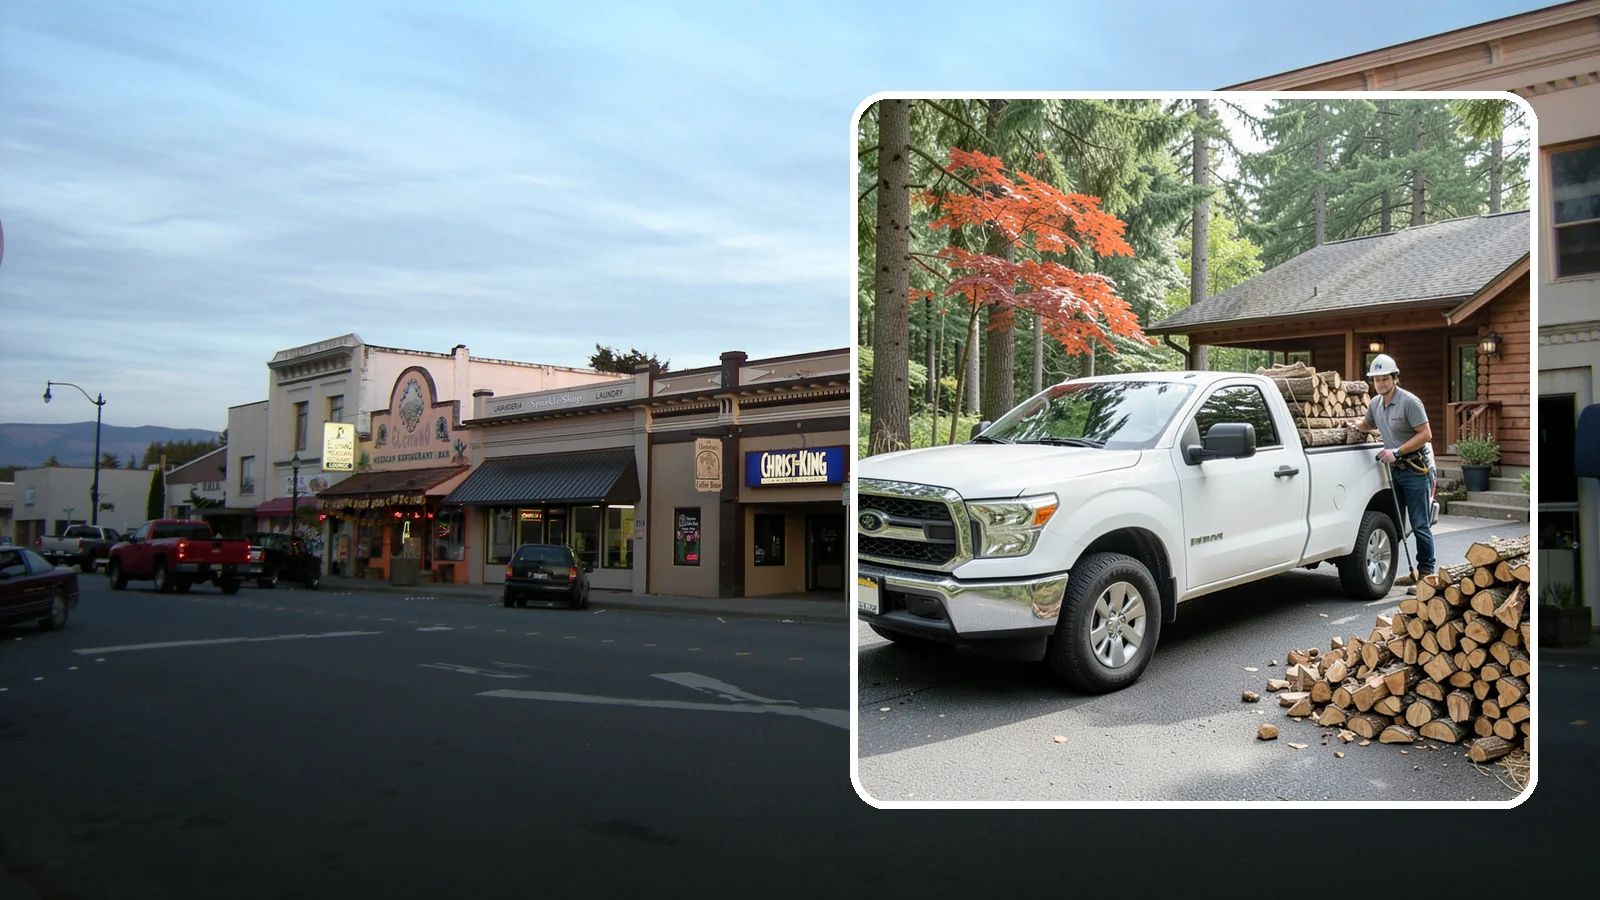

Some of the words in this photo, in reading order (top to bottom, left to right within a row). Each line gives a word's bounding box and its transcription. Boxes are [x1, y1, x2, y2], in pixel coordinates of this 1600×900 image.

[595, 389, 623, 400] LAUNDRY
[493, 402, 522, 413] LAVANDERIA
[531, 397, 560, 409] Sparkle
[562, 394, 582, 405] Shop
[373, 454, 396, 464] MEXICAN
[397, 451, 433, 462] RESTAURANT
[438, 450, 450, 459] BAR
[760, 452, 797, 478] CHRIST
[799, 450, 827, 477] KING
[696, 480, 709, 489] Coffee
[709, 480, 722, 489] House
